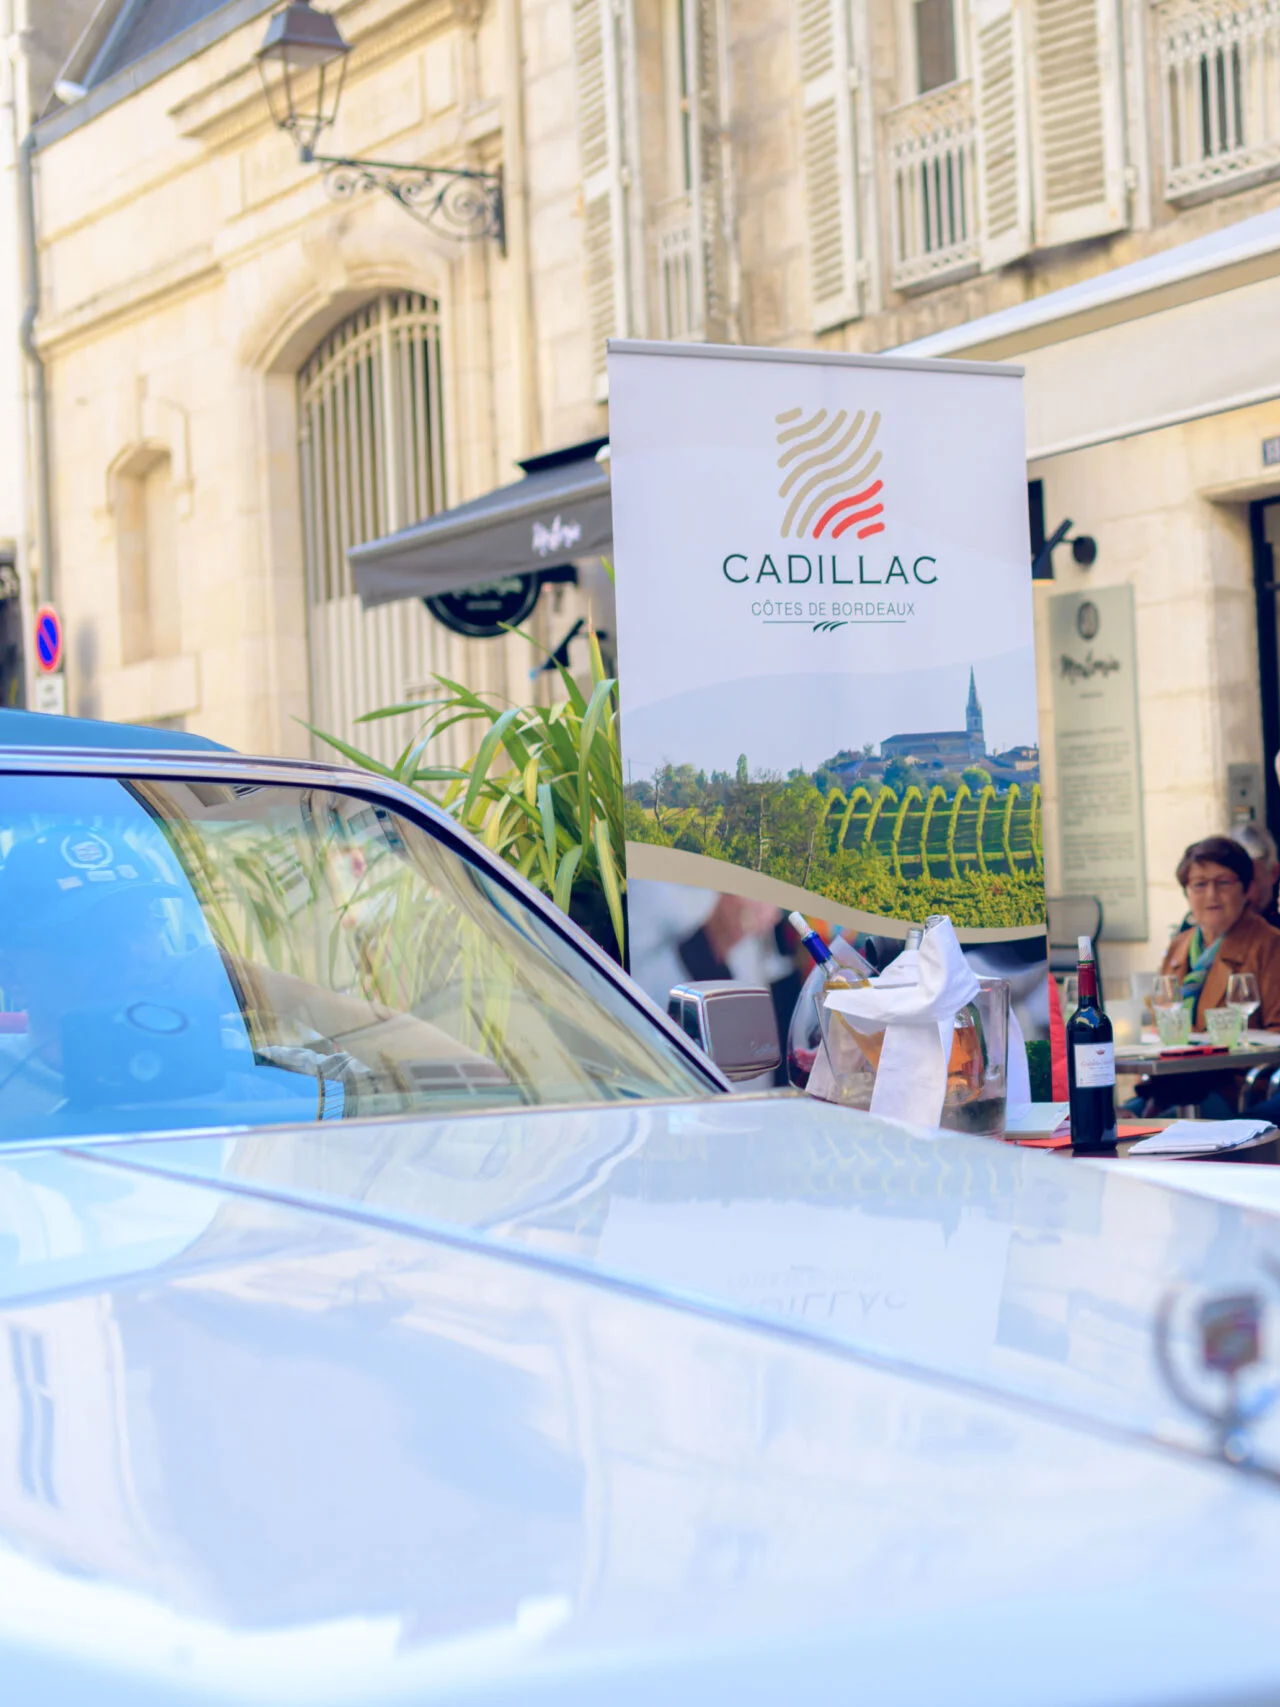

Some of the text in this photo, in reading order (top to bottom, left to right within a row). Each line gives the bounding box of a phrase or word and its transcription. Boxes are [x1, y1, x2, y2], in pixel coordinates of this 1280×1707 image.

[722, 553, 939, 585] CADILLAC
[751, 599, 916, 616] CÔTES DE BORDEAUX
